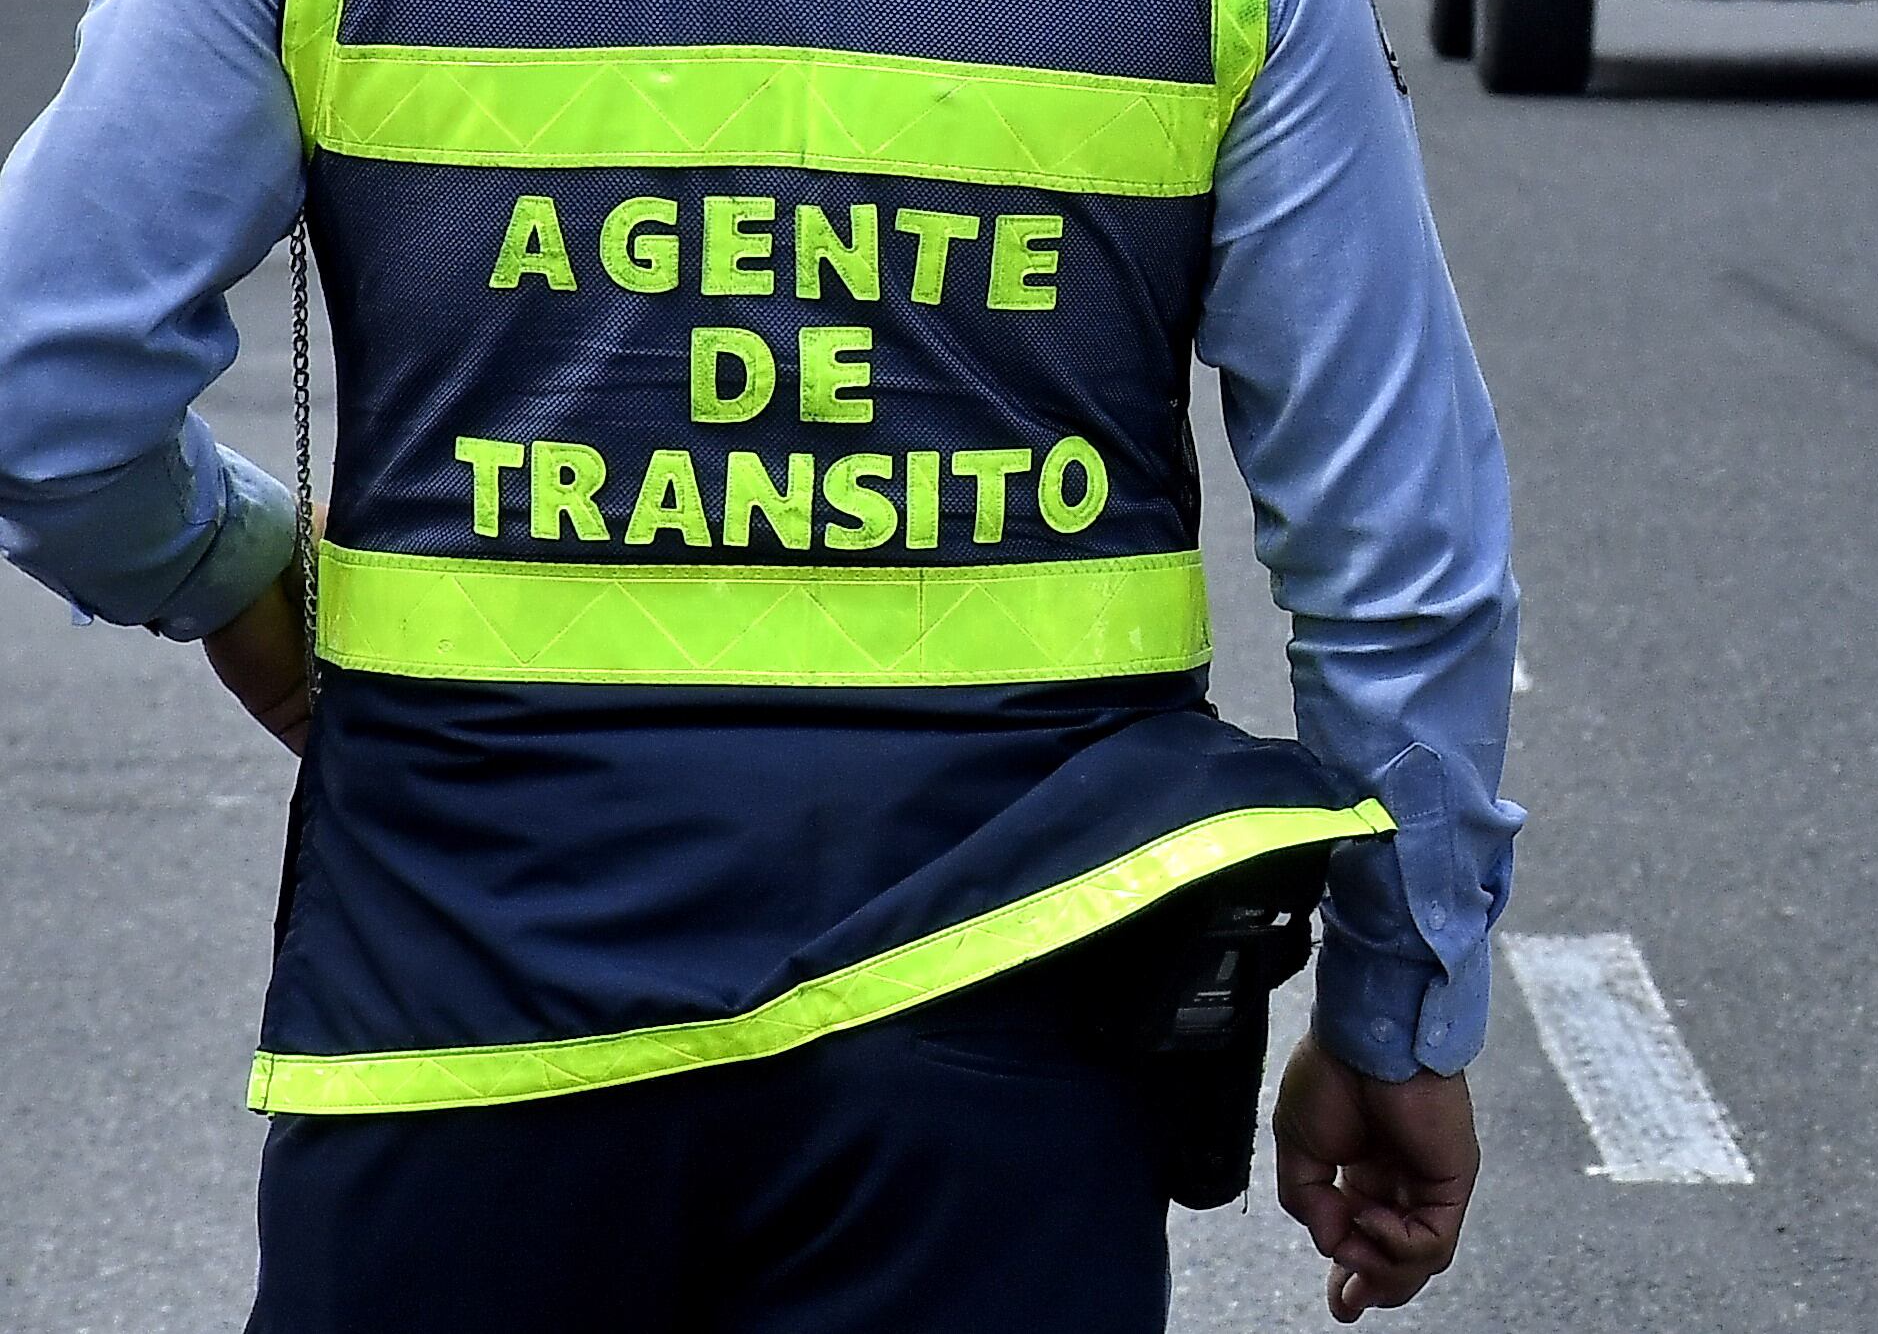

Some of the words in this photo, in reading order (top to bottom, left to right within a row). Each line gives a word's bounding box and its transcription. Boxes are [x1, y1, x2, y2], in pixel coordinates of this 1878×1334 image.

[489, 195, 1064, 311] AGENTE
[690, 326, 874, 424] DE
[454, 435, 1109, 551] TRANSITO
